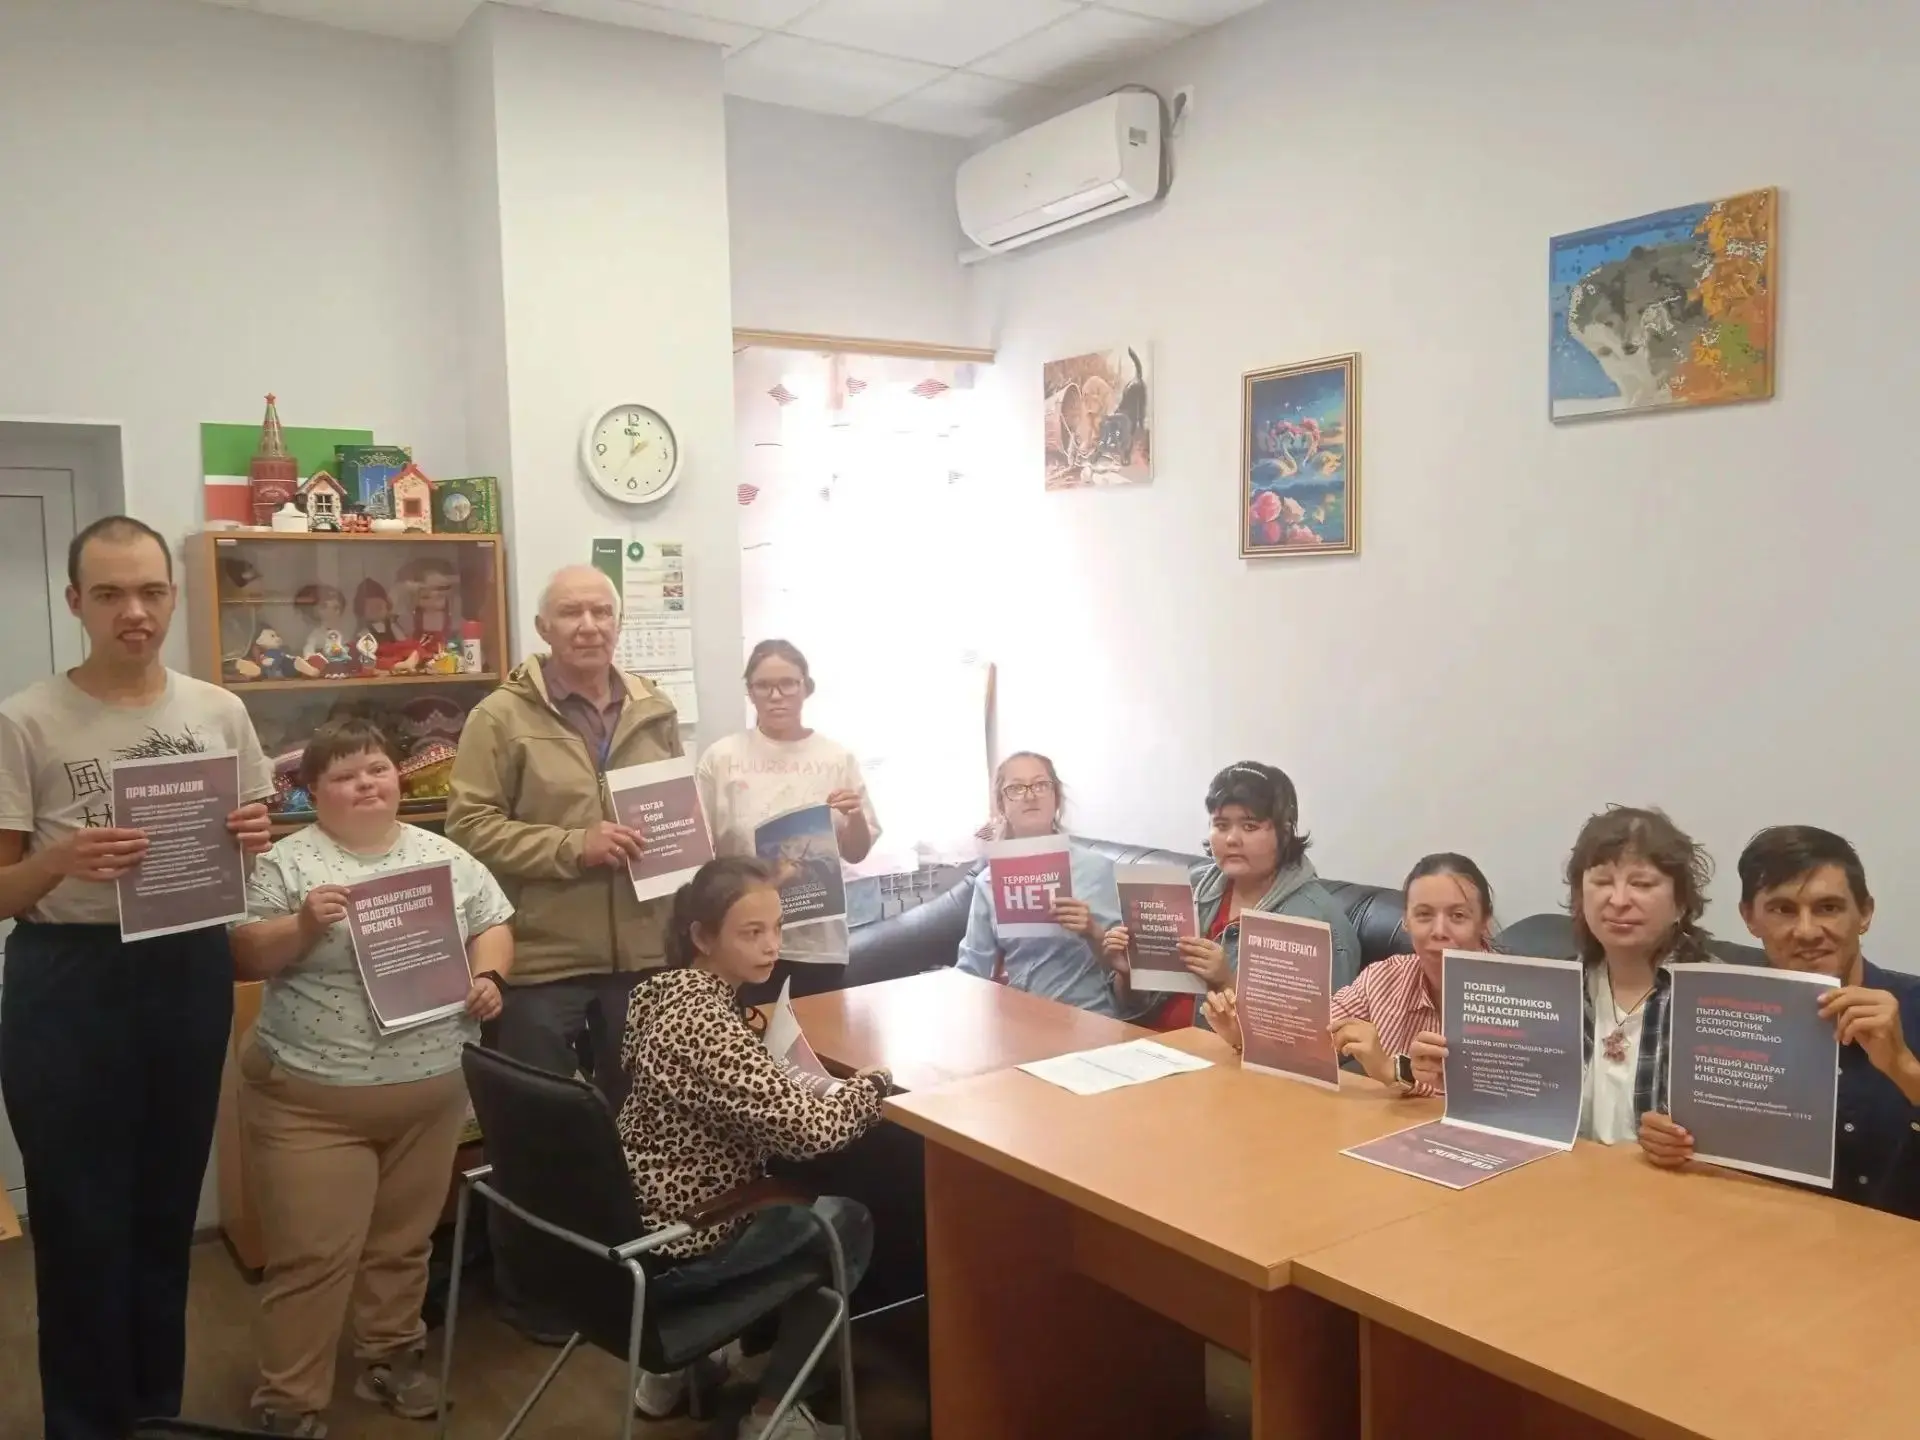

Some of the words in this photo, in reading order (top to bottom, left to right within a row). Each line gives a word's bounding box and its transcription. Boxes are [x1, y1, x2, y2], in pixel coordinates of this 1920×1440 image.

[627, 412, 640, 427] 12
[596, 443, 607, 456] 9
[627, 477, 638, 490] 6
[126, 786, 146, 799] ПРИ
[147, 780, 204, 797] ЭВАКУАЦИИ
[1003, 872, 1060, 885] ТЕРРОРИЗМУ
[355, 900, 373, 911] ПРИ
[373, 884, 433, 907] ОБНАРУЖЕНИИ
[1003, 882, 1060, 910] НЕТ
[358, 896, 434, 923] ПОДОЗРИТЕЛЬНОГО
[361, 917, 403, 935] ПРЕДМЕТА
[1248, 934, 1263, 948] ПРИ
[1263, 938, 1287, 953] УГРОЗЕ
[1287, 942, 1317, 957] ТЕРАКТА
[1464, 981, 1505, 993] ПОЛЕТЫ
[1464, 993, 1552, 1009] БЕСПИЛОТНИКОВ
[1463, 1013, 1519, 1028] ПУНКТАМИ
[1464, 1003, 1485, 1013] НАД
[1487, 1005, 1559, 1022] НАСЕЛЕННЫМ
[1696, 1007, 1742, 1019] ПЫТАТЬСЯ
[1743, 1012, 1772, 1023] СБИТЬ
[1696, 1017, 1763, 1032] БЕСПИЛОТНИК
[1695, 1026, 1782, 1044] САМОСТОЯТЕЛЬНО
[1694, 1054, 1742, 1067] УПАВШИЙ
[1744, 1063, 1786, 1075] АППАРАТ
[1695, 1064, 1702, 1072] И
[1703, 1066, 1715, 1074] НЕ
[1717, 1066, 1774, 1083] ПОДХОДИТЕ
[1694, 1074, 1732, 1086] БЛИЗКО
[1742, 1081, 1768, 1091] НЕМУ
